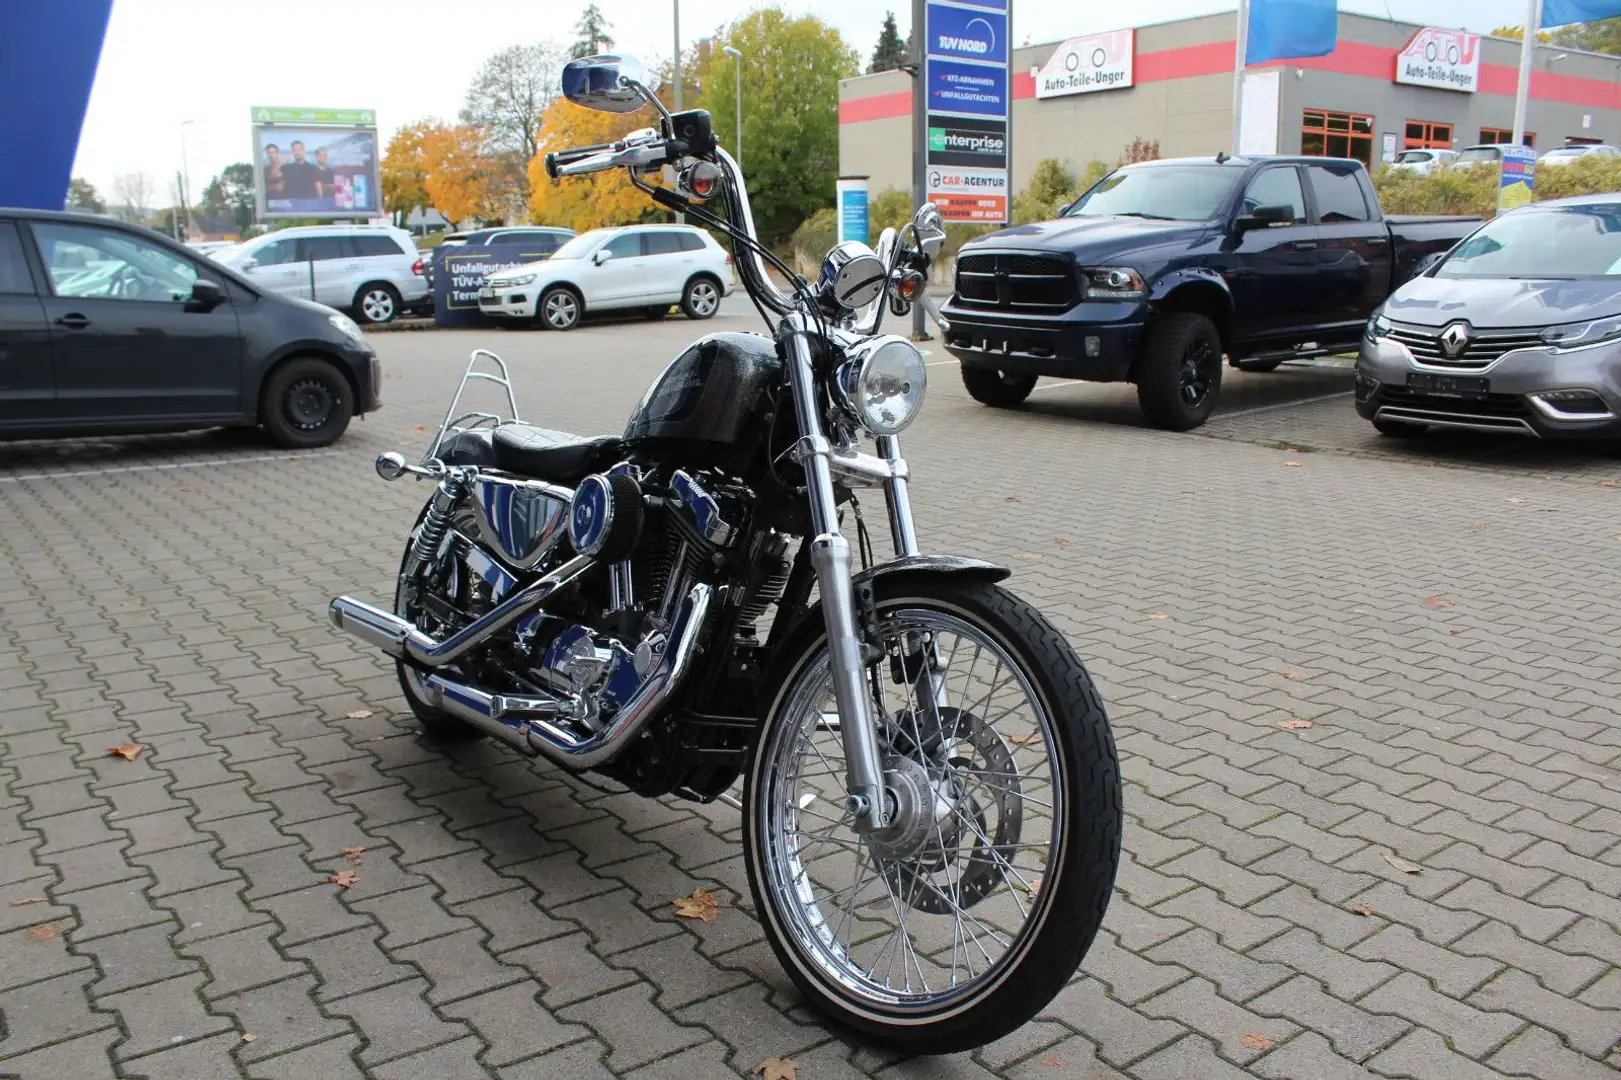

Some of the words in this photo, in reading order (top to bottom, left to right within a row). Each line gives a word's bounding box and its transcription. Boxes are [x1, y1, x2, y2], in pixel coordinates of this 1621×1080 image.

[939, 36, 958, 50] TÜV
[958, 38, 987, 53] NORD
[947, 74, 995, 87] KFZ-ABNAHMEN
[1044, 71, 1125, 91] Auto-Teile-Unger
[1405, 63, 1472, 86] Auto-Teile-Unger
[941, 90, 1000, 103] UNFALLGUTACHTEN
[934, 133, 1004, 150] enterprise
[984, 211, 1003, 219] AUTO
